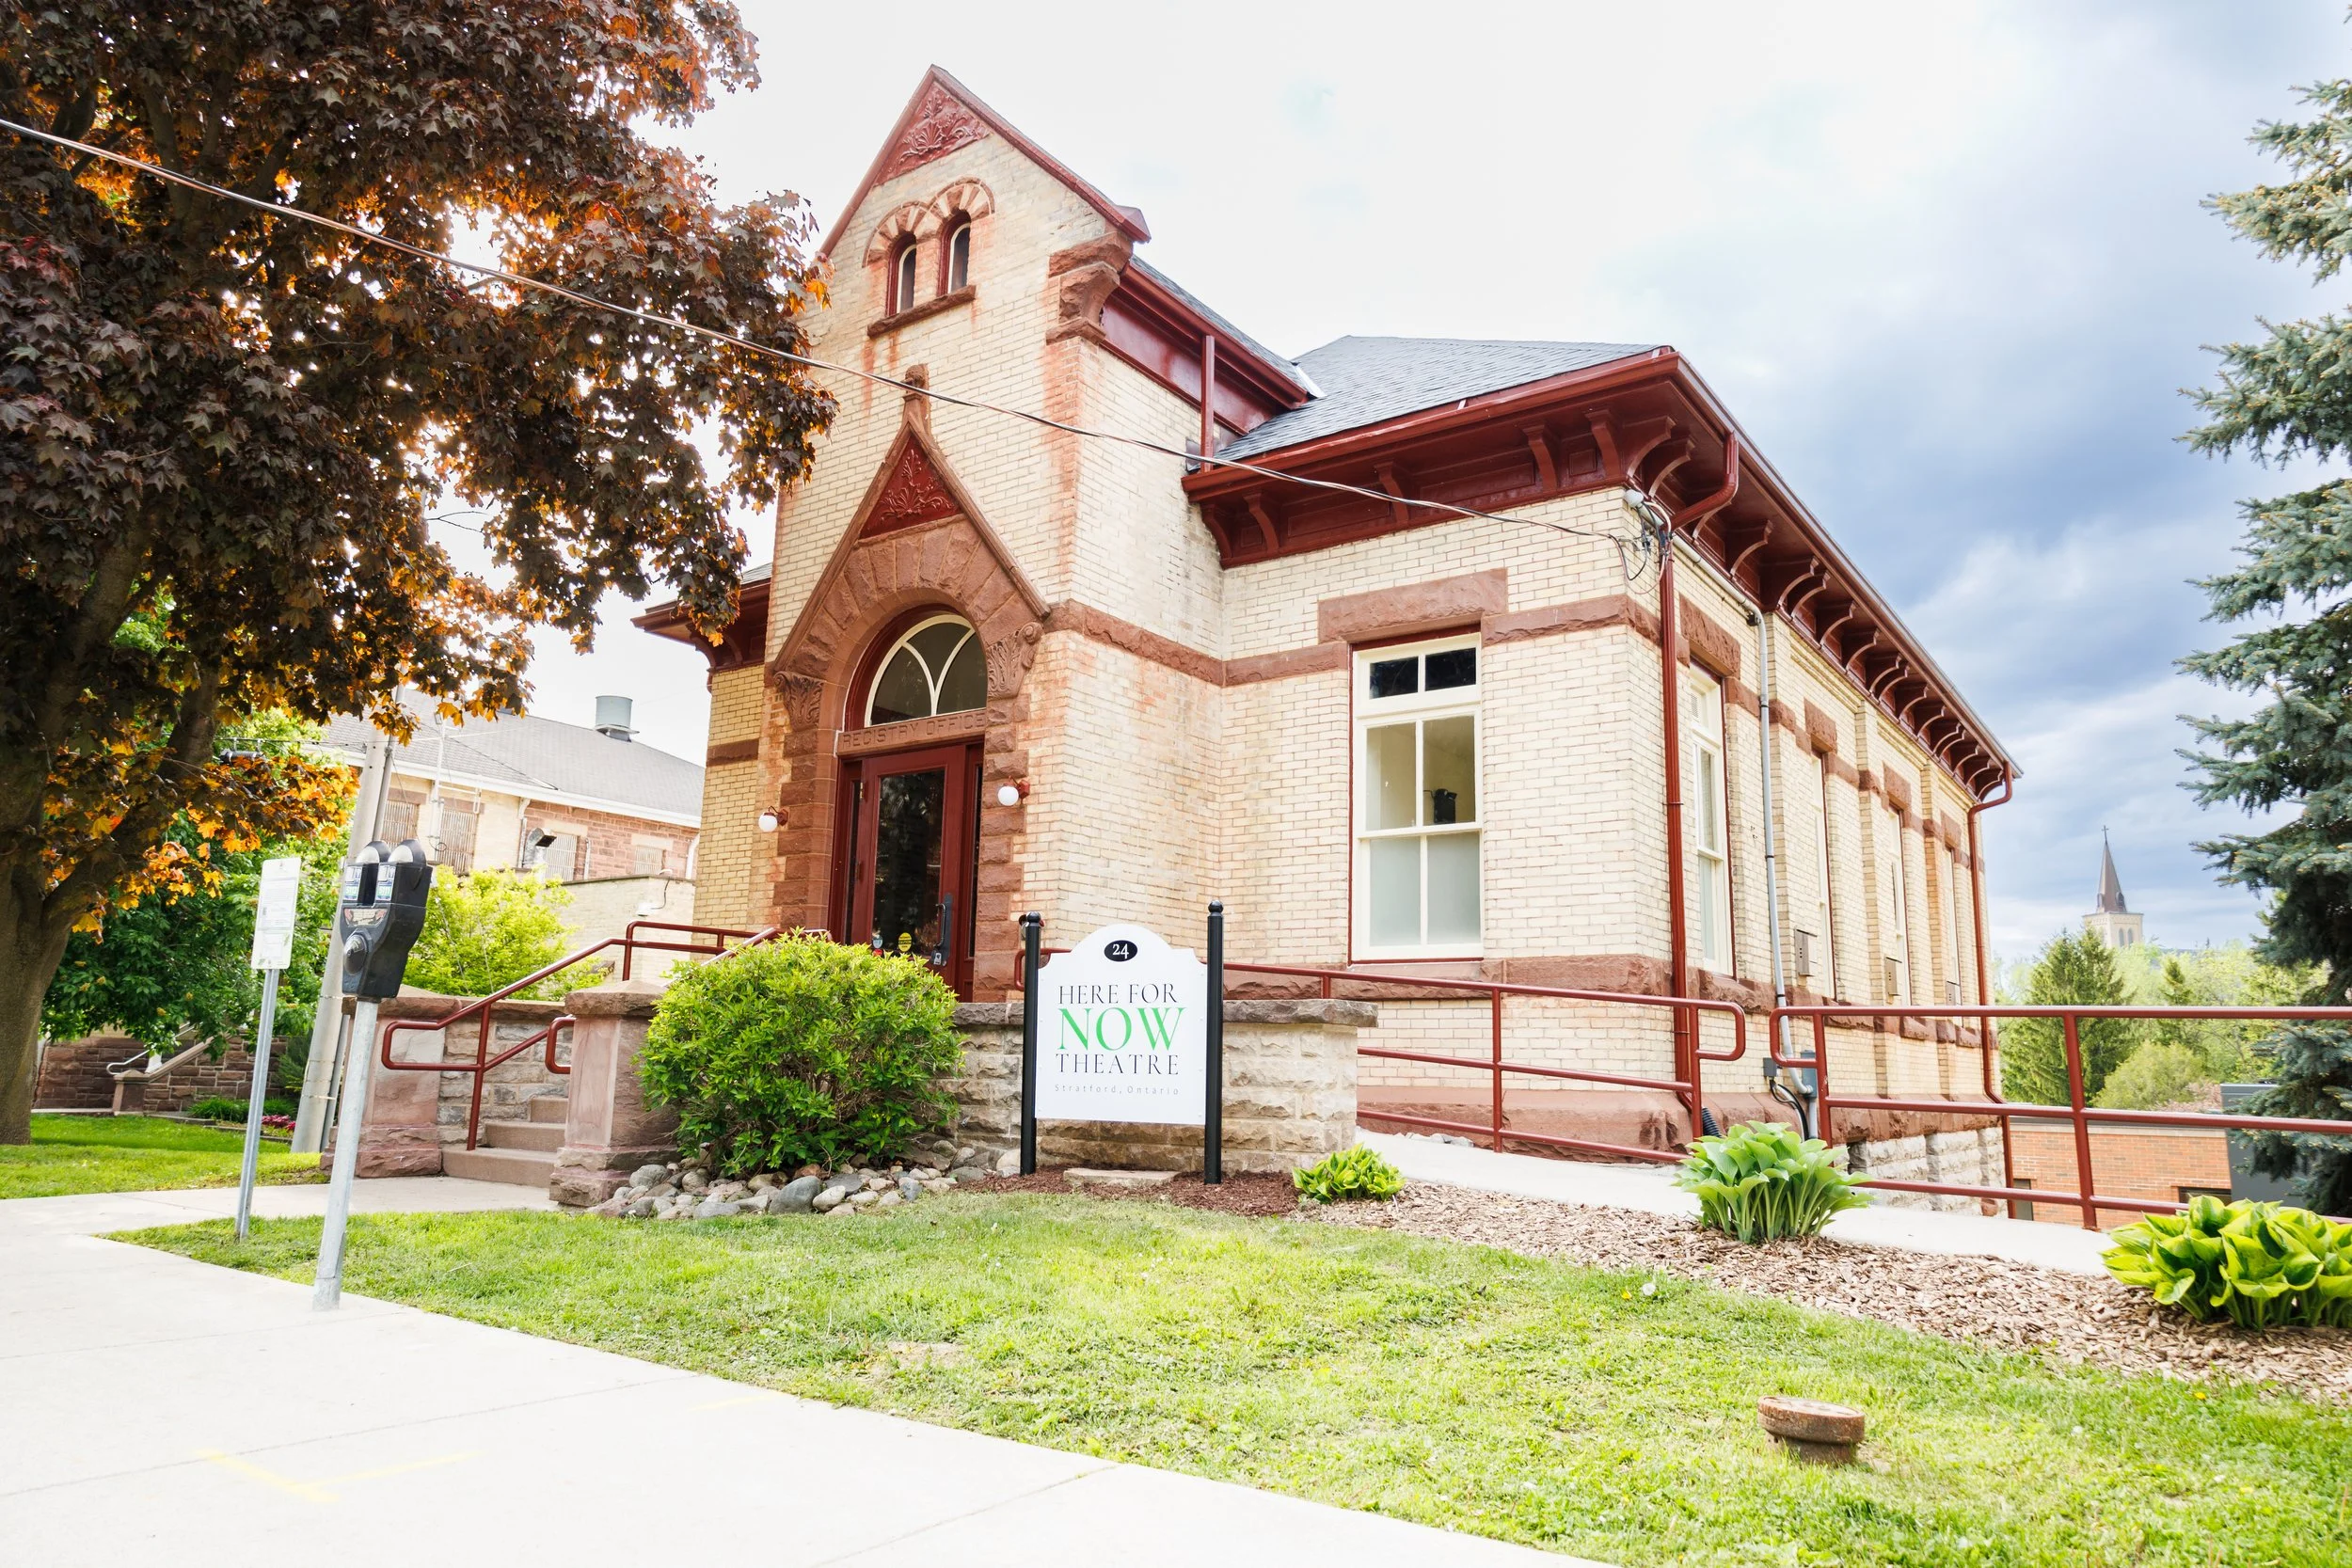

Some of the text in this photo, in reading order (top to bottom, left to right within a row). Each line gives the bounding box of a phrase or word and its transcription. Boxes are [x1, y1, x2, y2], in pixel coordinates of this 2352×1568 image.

[842, 713, 986, 749] REGISTRY OFFICE
[1113, 943, 1130, 958] 24
[1058, 983, 1177, 1005] HERE FOR
[1057, 1007, 1185, 1051] NOW
[1056, 1053, 1179, 1075] THEATRE
[1055, 1084, 1179, 1095] Stratford, Ontario
